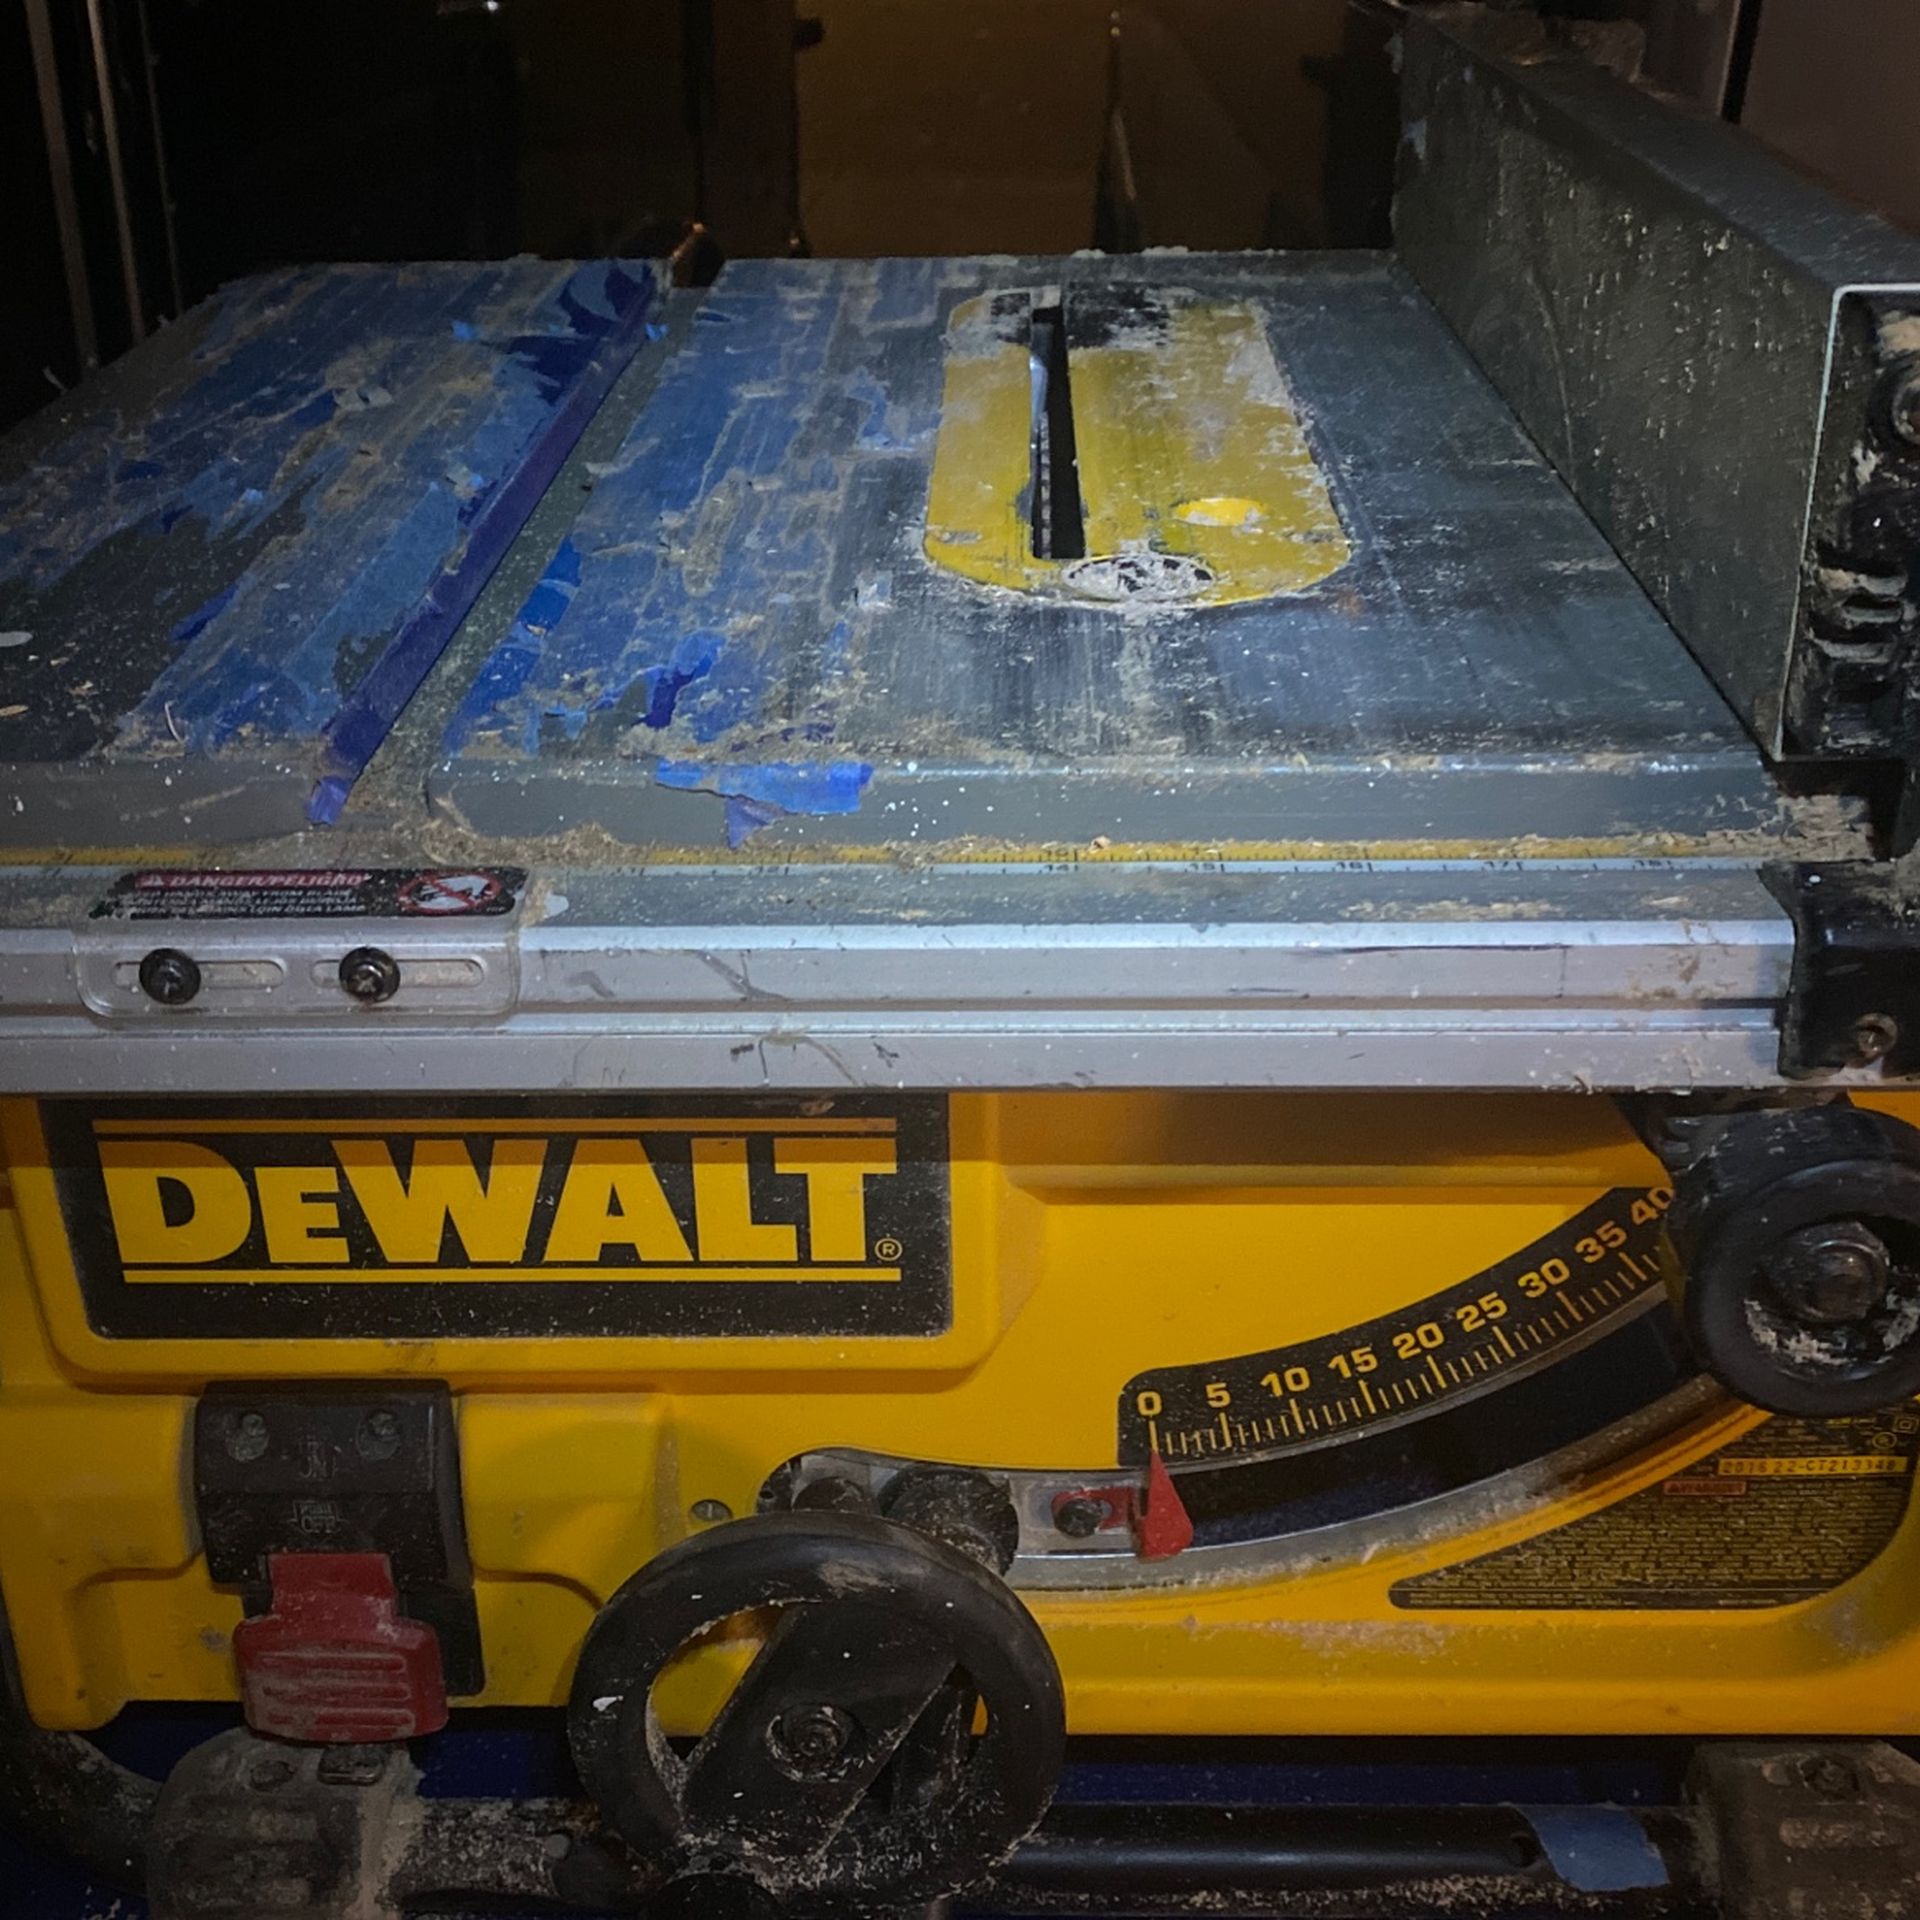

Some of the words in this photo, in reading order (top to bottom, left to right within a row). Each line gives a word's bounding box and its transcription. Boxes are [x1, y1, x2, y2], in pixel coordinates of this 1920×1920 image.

[97, 1137, 898, 1263] DEWALT
[1137, 1391, 1162, 1416] 0
[1206, 1383, 1230, 1409] 5
[1260, 1367, 1310, 1398] 10
[1327, 1346, 1379, 1380] 15
[1392, 1322, 1445, 1359] 20
[1455, 1292, 1508, 1333] 25
[1517, 1257, 1570, 1299] 30
[1574, 1221, 1628, 1265] 35
[1629, 1186, 1675, 1227] 40
